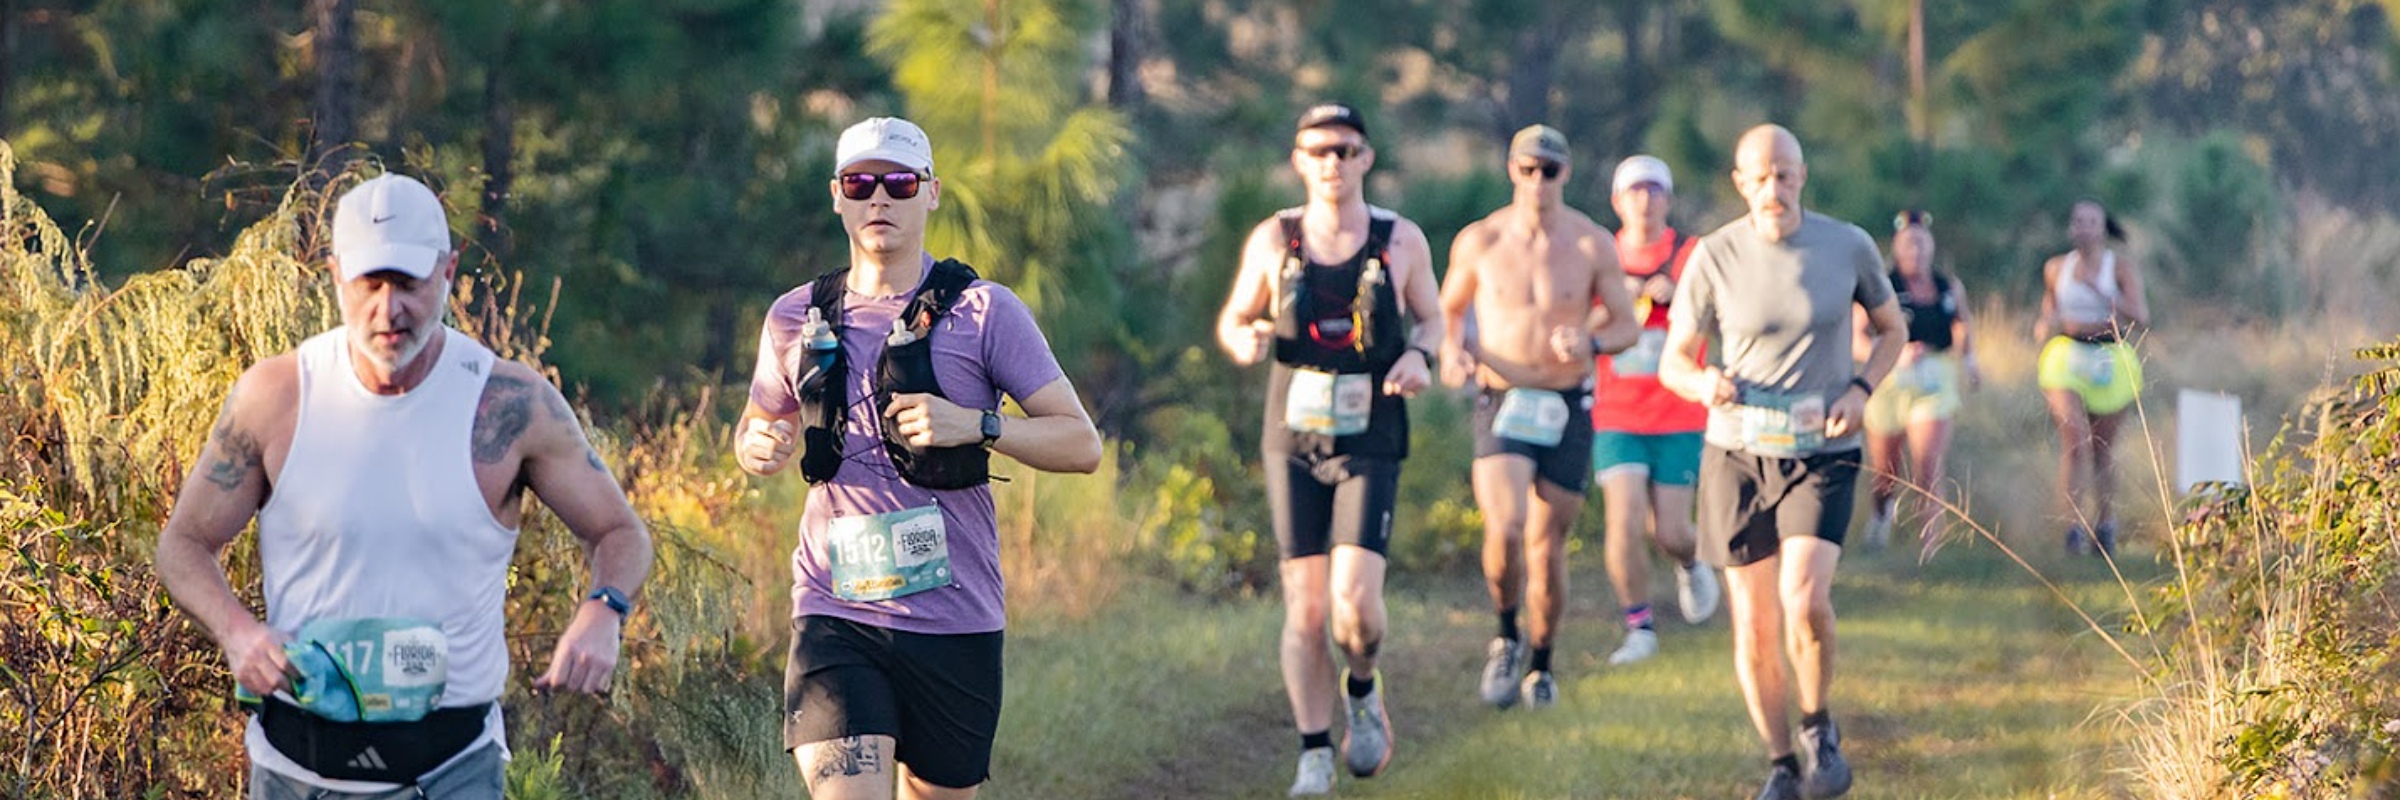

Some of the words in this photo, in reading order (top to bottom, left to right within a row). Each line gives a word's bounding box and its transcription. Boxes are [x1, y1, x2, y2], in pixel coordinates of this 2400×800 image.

[832, 533, 888, 566] 1512
[901, 528, 938, 552] FLORIDA
[393, 644, 436, 667] FLORIDA
